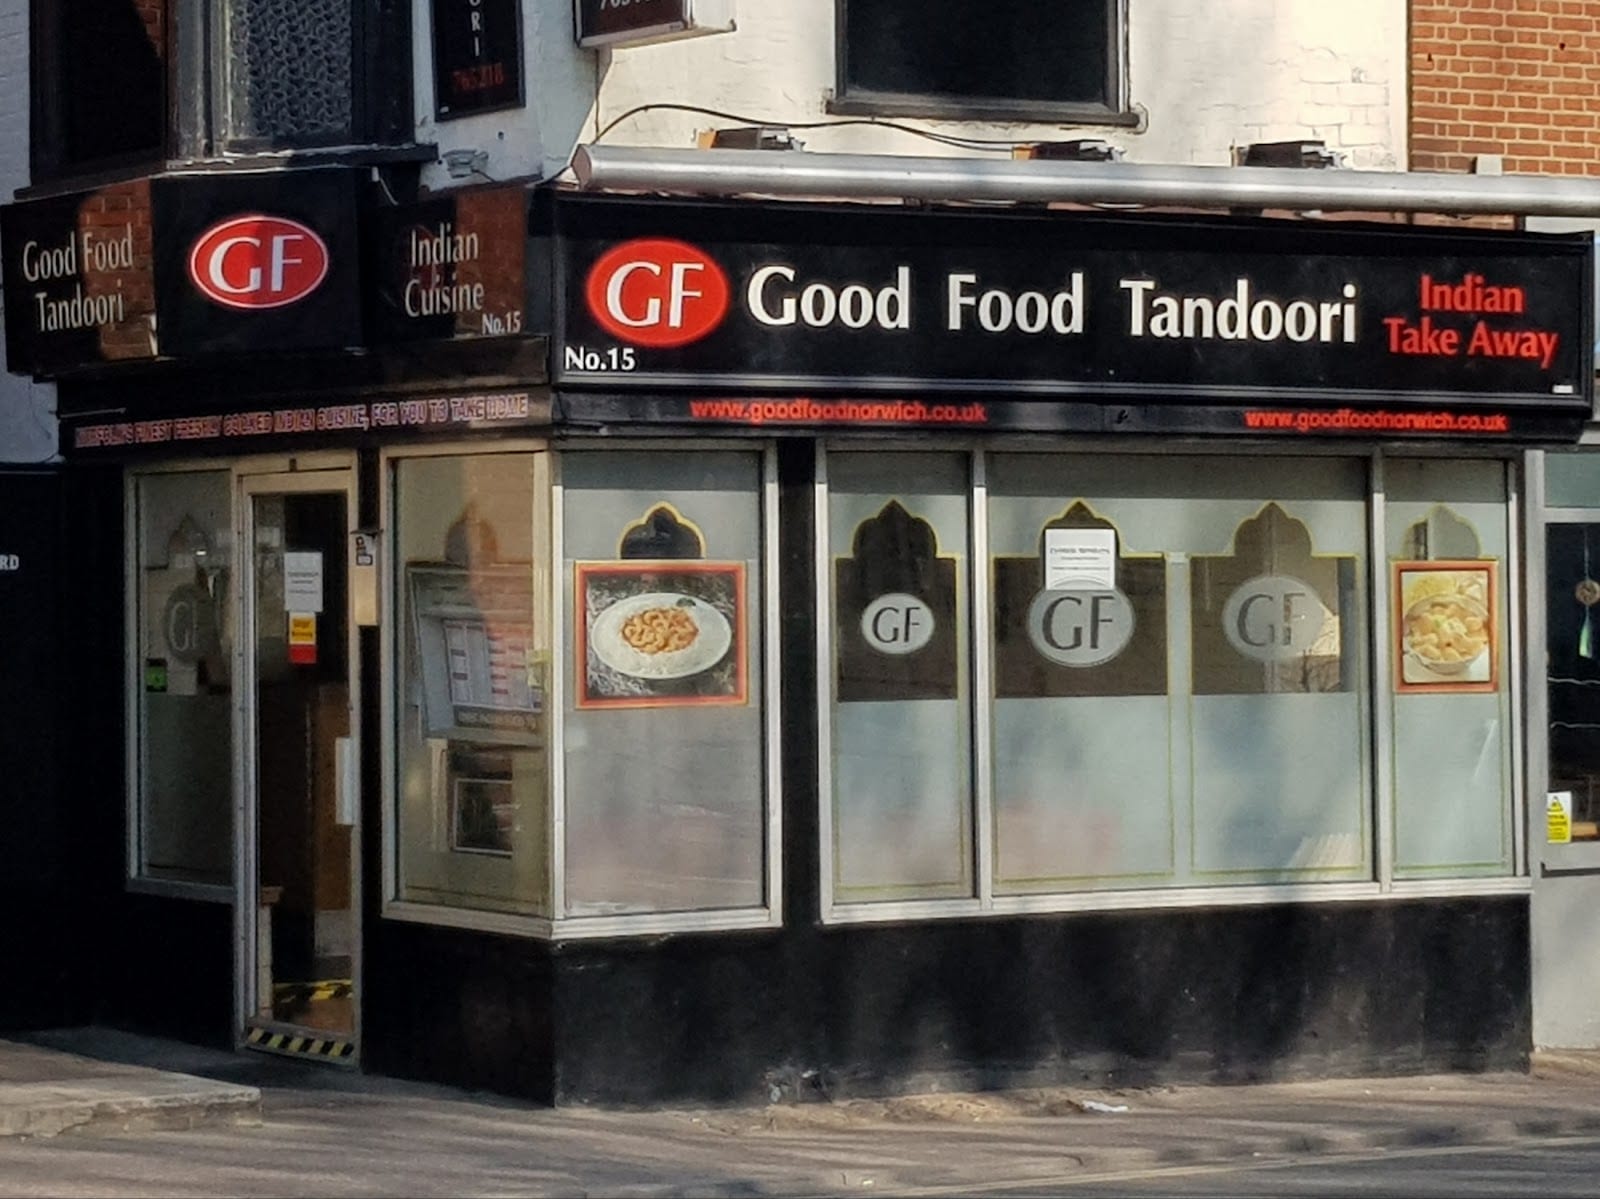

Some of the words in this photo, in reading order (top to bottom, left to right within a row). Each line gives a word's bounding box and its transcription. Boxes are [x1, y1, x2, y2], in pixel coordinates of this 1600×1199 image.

[22, 239, 77, 282] Good
[83, 222, 133, 273] Food
[208, 234, 304, 295] GF
[410, 222, 479, 267] Indian
[35, 280, 125, 333] Tandoori
[404, 274, 485, 318] Cuisine
[606, 261, 704, 328] GF
[747, 265, 910, 329] Good
[948, 272, 1084, 334] Food
[1119, 278, 1356, 343] Tandoori
[1420, 273, 1524, 315] Indian
[481, 311, 522, 336] No.15
[1383, 317, 1458, 356] Take
[1468, 322, 1559, 370] Away
[564, 346, 636, 371] No.15
[371, 402, 399, 427] FOR
[690, 399, 988, 424] www.goodfoodnorwich.co.uk
[1244, 408, 1507, 432] www.goodfoodnorwich.co.uk
[871, 605, 921, 644] GF
[1041, 595, 1114, 651] GF
[1236, 592, 1306, 649] GF
